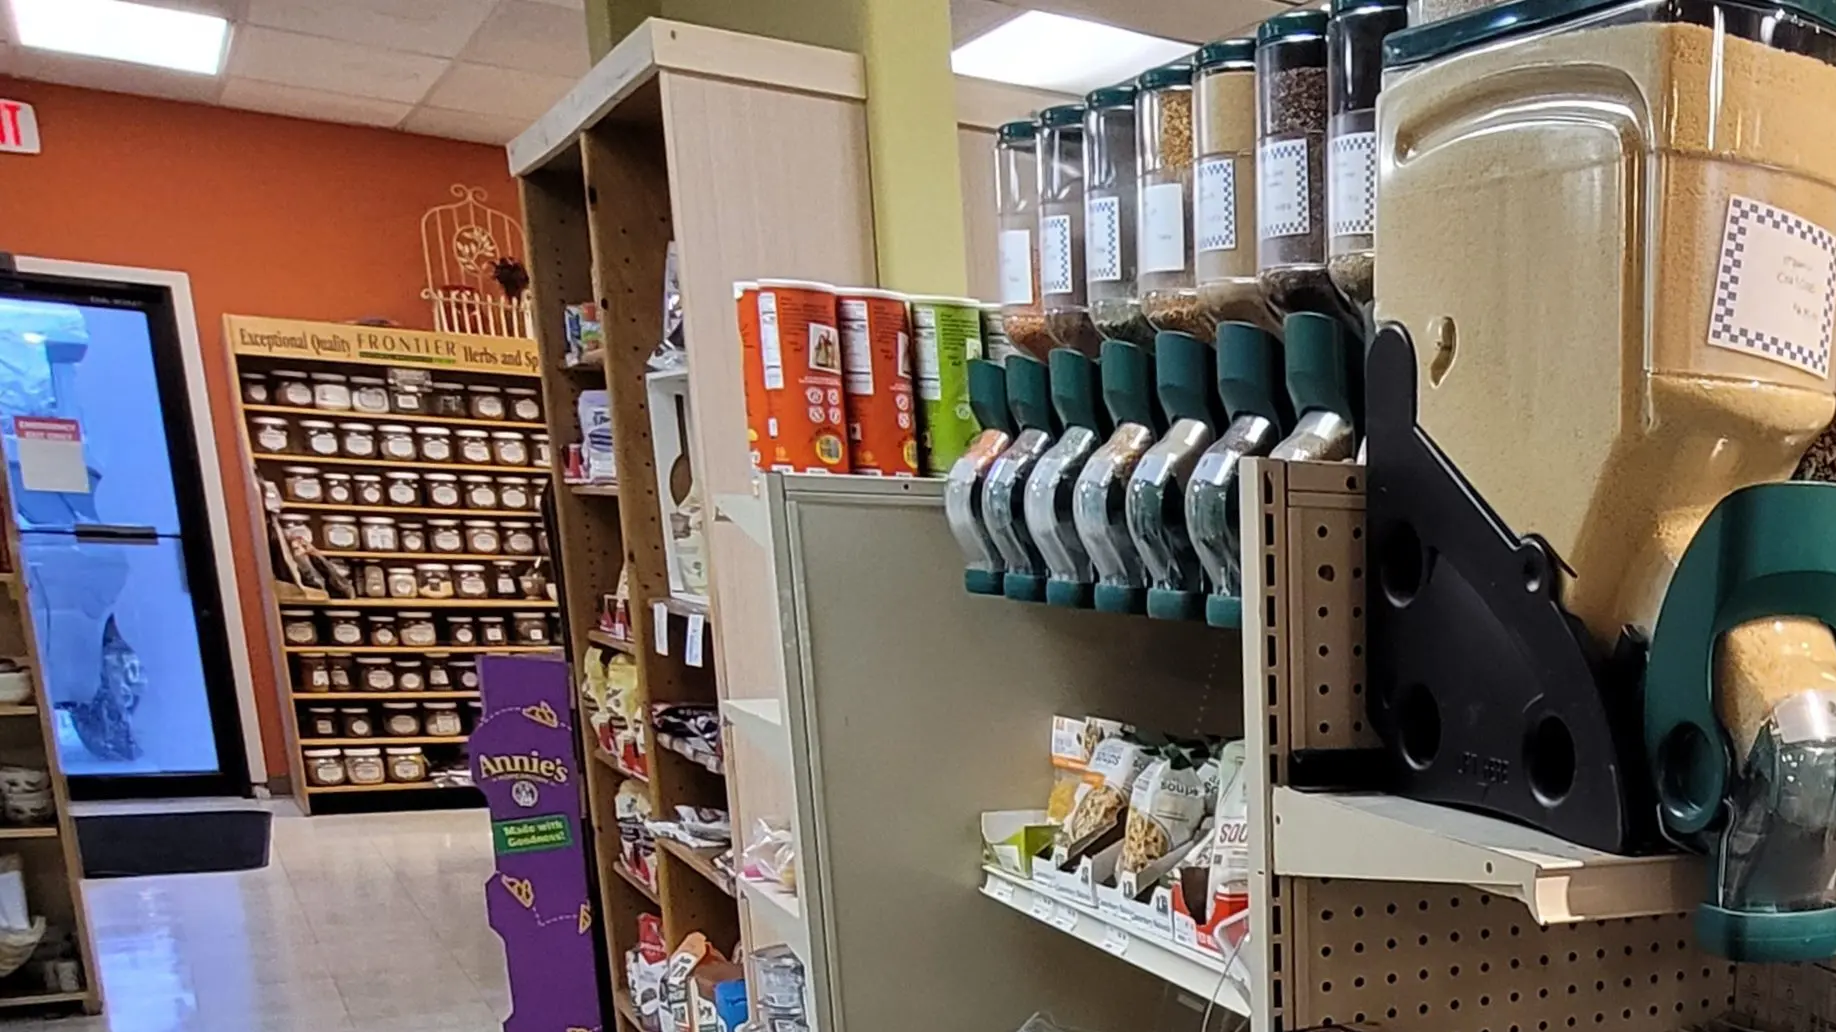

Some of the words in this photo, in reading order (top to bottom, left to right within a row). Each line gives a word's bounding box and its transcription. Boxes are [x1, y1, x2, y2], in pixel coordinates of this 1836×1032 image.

[240, 328, 307, 349] Exceptional
[311, 334, 350, 356] Quality
[357, 333, 456, 355] FRONTIER
[464, 345, 498, 365] Herbs
[502, 352, 523, 366] and
[479, 750, 568, 783] Annie's
[1219, 823, 1248, 844] SOU
